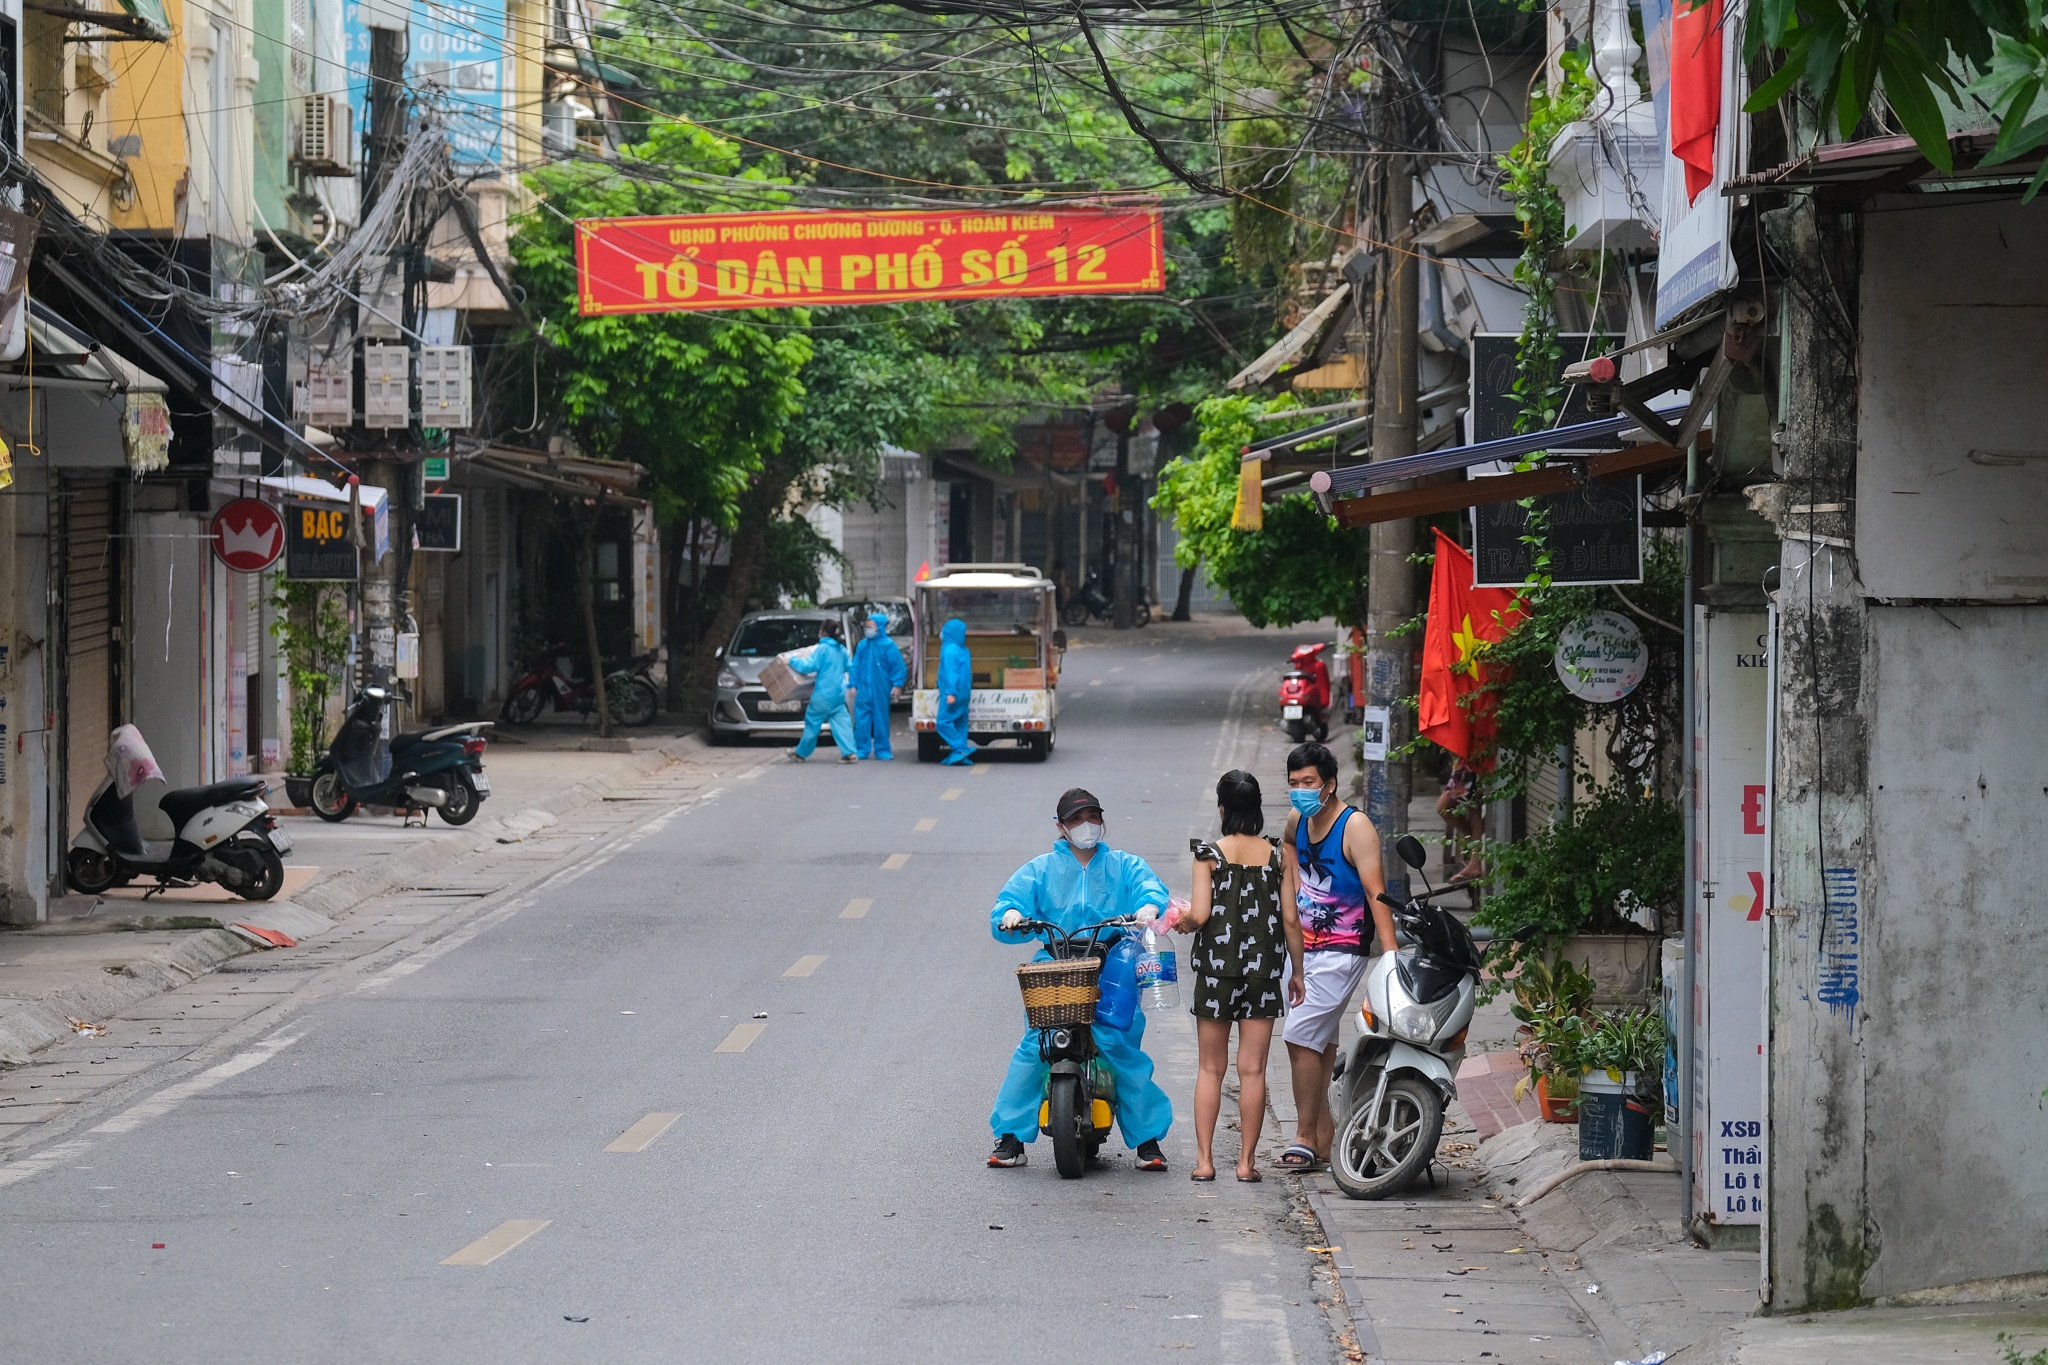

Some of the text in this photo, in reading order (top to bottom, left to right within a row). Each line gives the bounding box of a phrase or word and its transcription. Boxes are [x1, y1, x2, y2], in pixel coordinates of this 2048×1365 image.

[669, 228, 717, 245] UBND
[720, 222, 790, 243] PHƯỜNG
[793, 222, 862, 241] CHƯƠNG
[636, 234, 1108, 299] TỔ DÂN PHỐ SỐ 12
[302, 510, 343, 546] BẠC
[1487, 545, 1567, 575] TRAG
[1722, 1144, 1762, 1165] Thầ
[1724, 1172, 1747, 1190] Lô
[1726, 1195, 1762, 1213] Lô t
